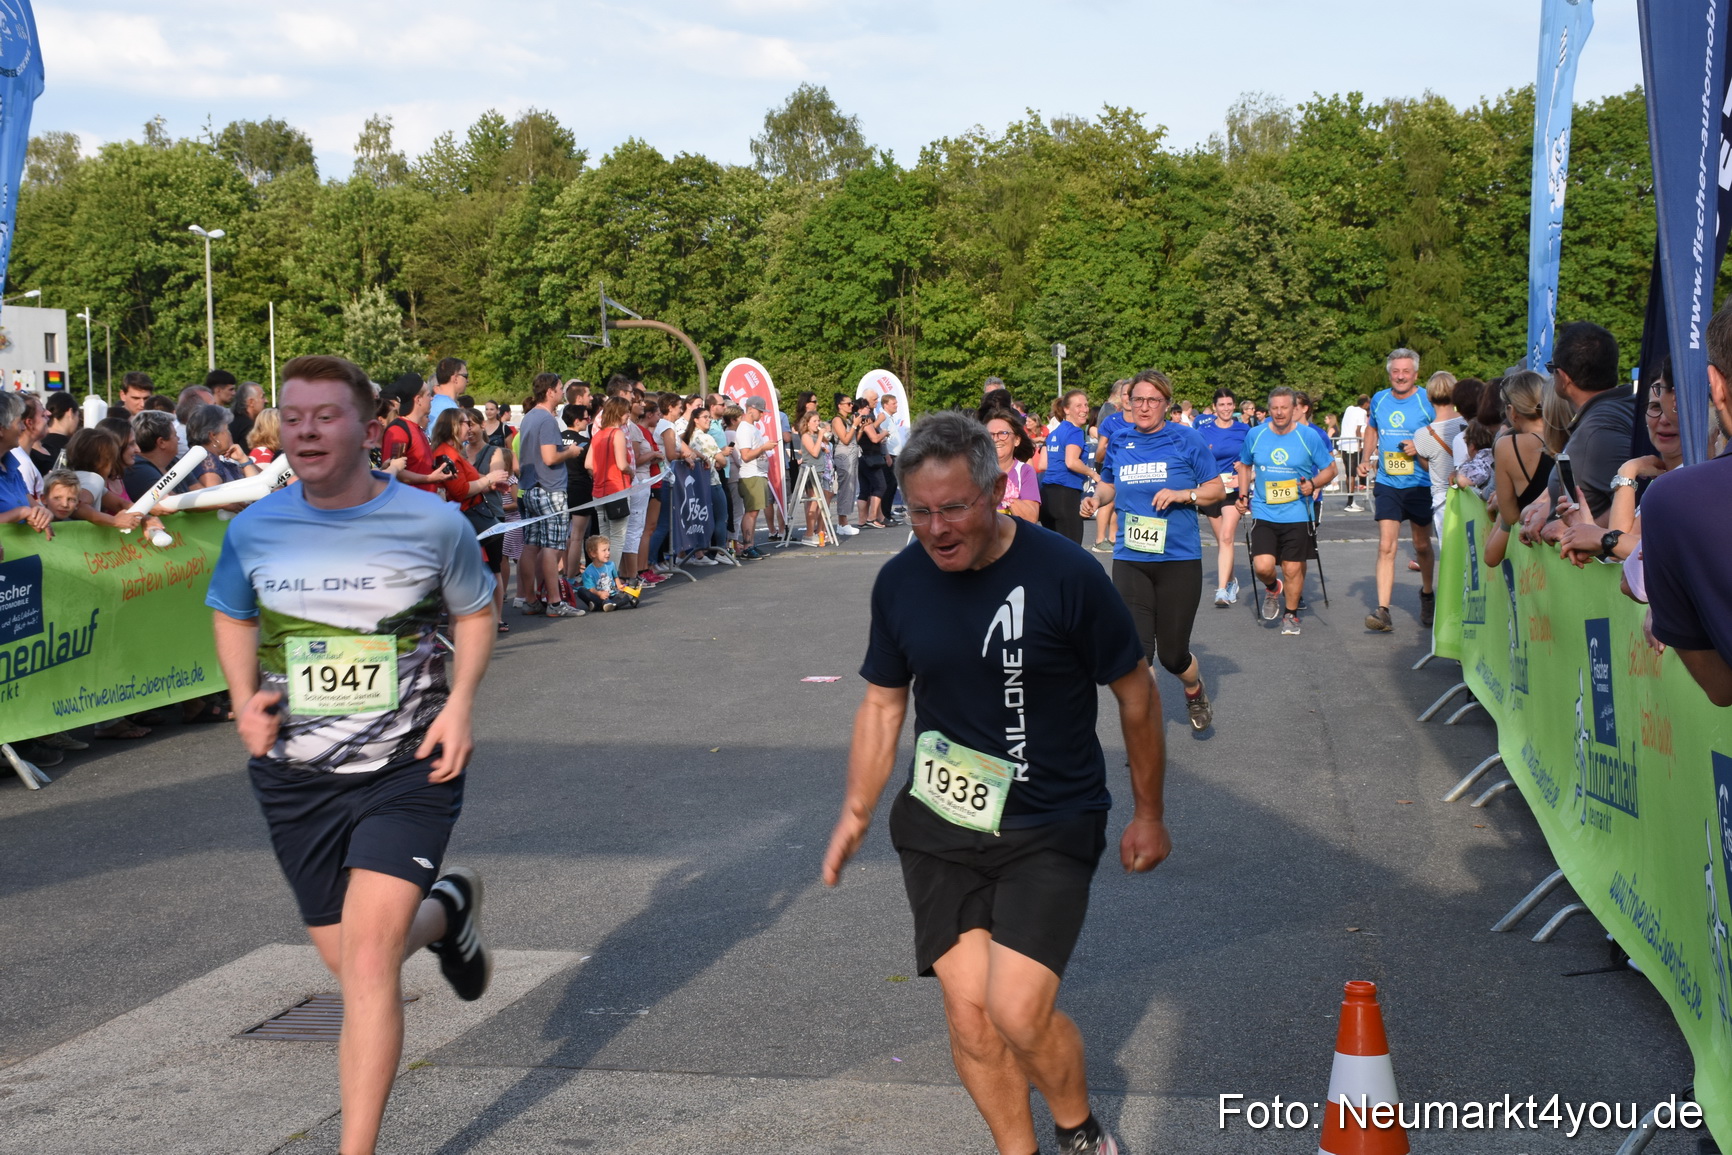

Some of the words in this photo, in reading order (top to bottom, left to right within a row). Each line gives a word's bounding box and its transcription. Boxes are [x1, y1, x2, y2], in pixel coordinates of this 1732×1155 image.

[1119, 462, 1167, 476] HUBER
[1388, 460, 1406, 469] 986
[1272, 488, 1291, 498] 976
[1128, 526, 1159, 543] 1044
[84, 536, 143, 575] Gesunde
[121, 566, 163, 602] laufen
[164, 546, 212, 589] länger!
[302, 664, 381, 692] 1947
[925, 760, 989, 811] 1938
